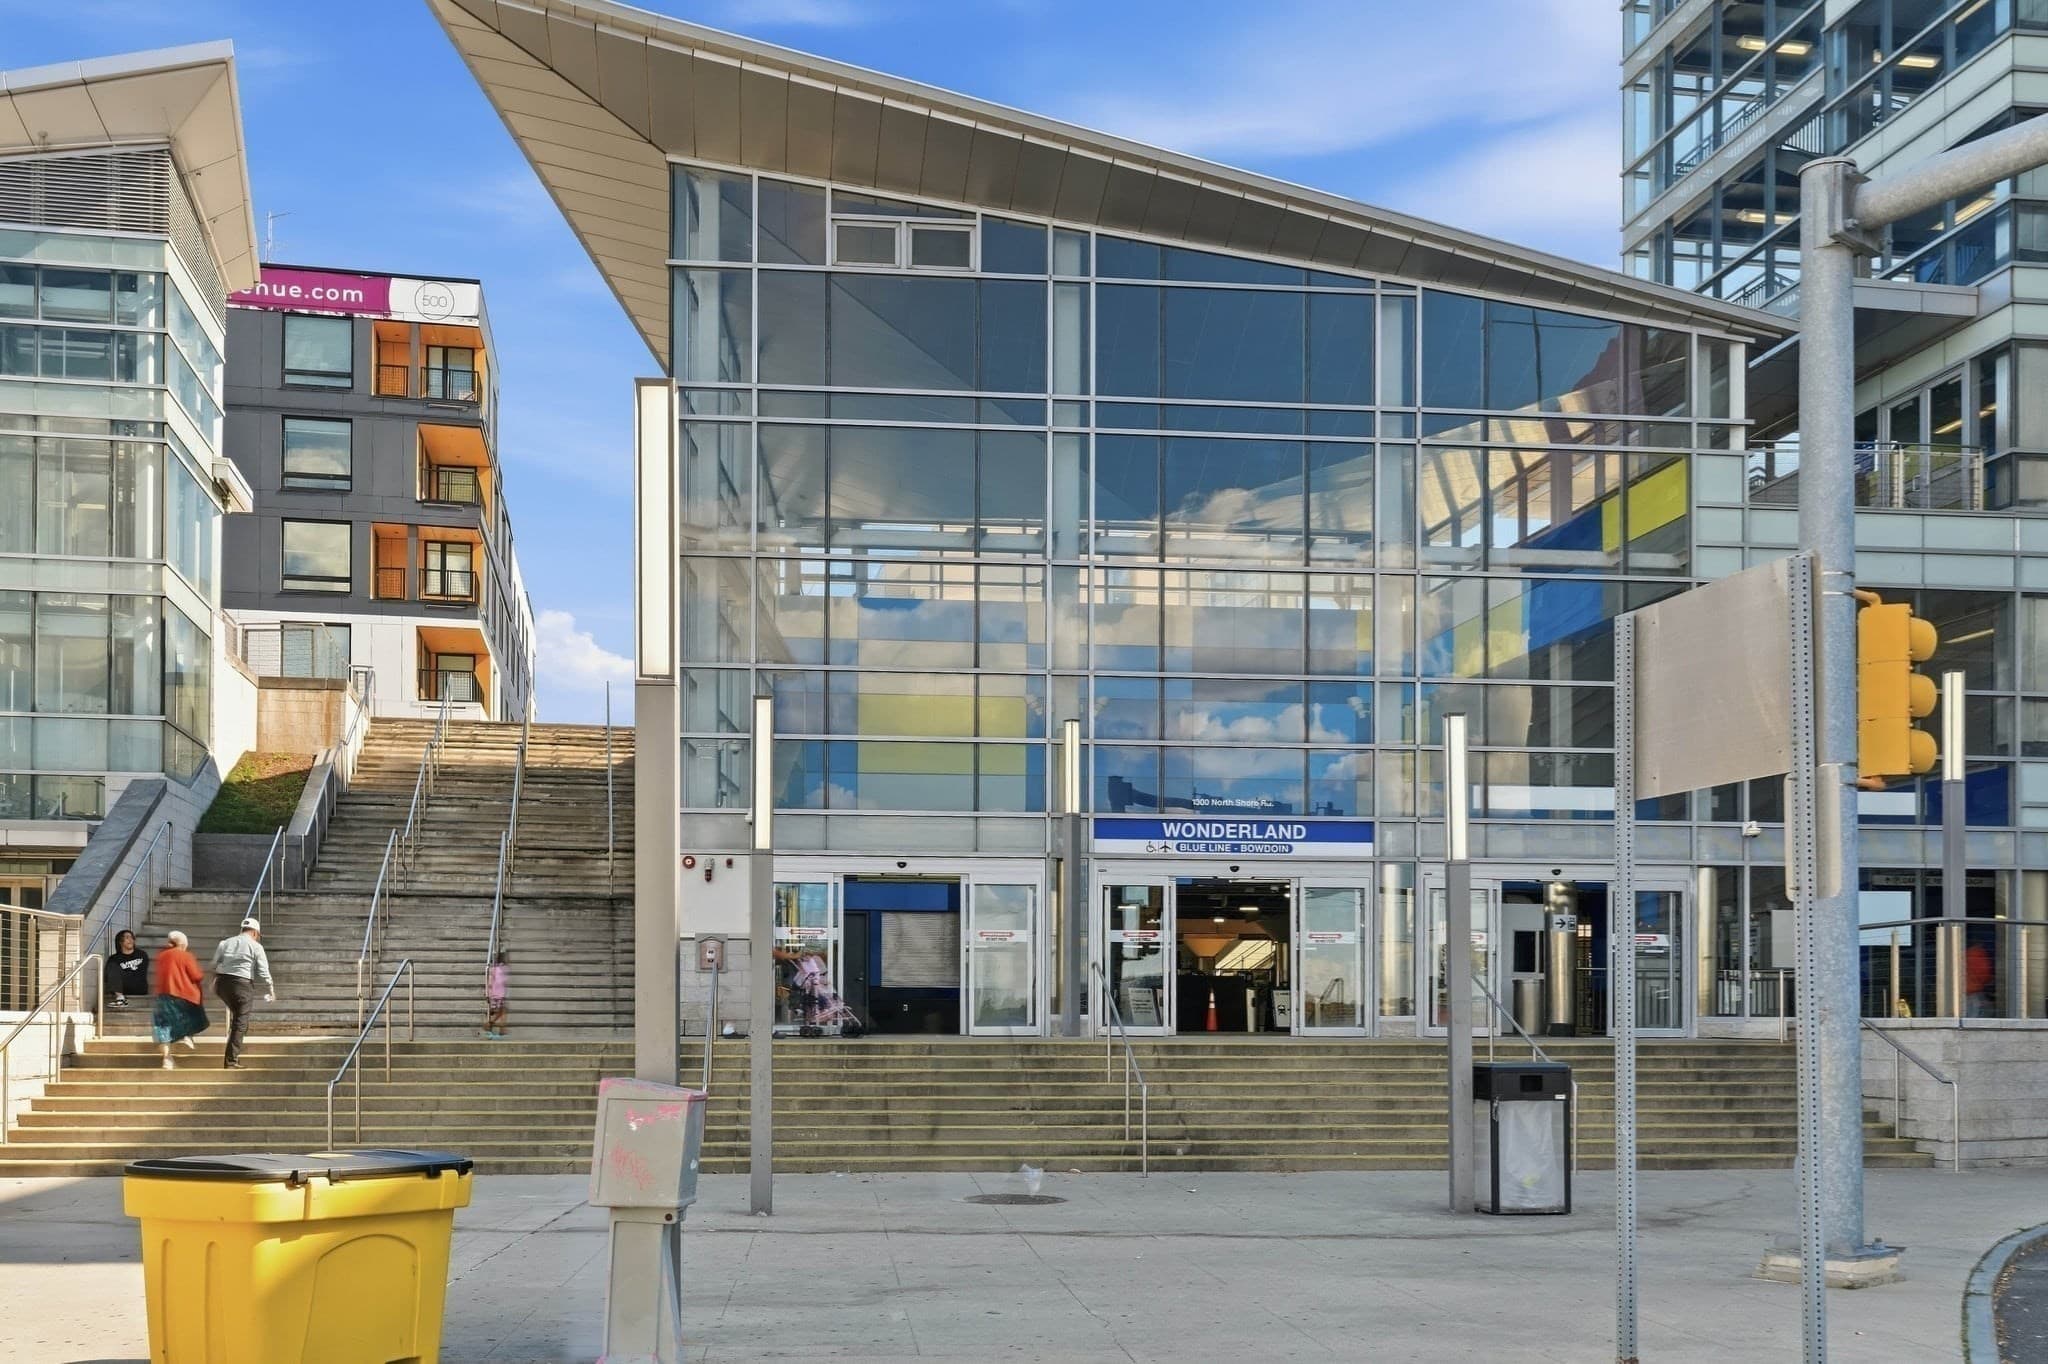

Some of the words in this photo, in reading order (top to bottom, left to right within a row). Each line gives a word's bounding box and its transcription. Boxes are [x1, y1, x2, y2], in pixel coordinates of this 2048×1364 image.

[240, 282, 363, 303] nue.com
[422, 294, 448, 308] 500
[1161, 822, 1307, 840] WONDERLAND
[1179, 842, 1207, 853] BLUE
[1208, 843, 1232, 853] LINE
[1240, 843, 1290, 854] BOWDOIN
